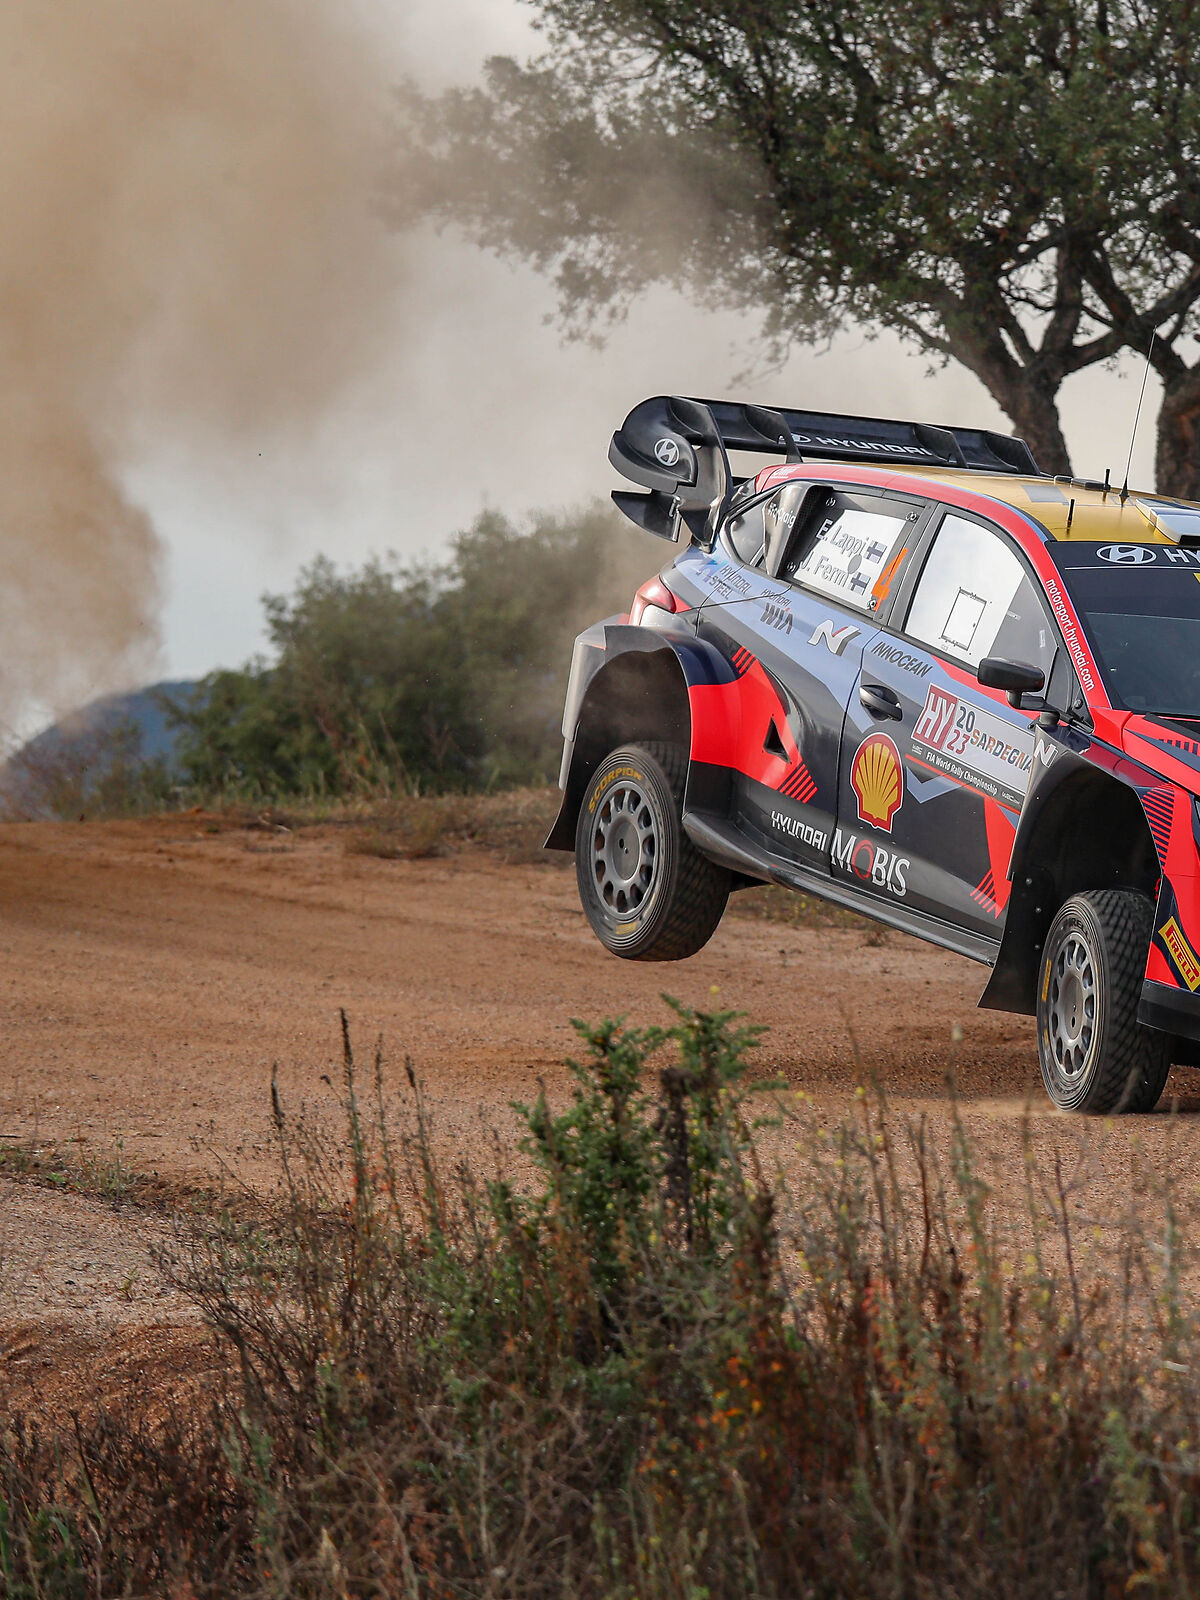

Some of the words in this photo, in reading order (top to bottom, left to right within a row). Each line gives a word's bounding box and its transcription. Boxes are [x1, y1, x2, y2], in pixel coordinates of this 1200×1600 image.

[816, 437, 933, 456] HYUNDAI
[816, 519, 834, 541] E.
[830, 525, 870, 558] Lappi
[709, 575, 734, 600] STEEL
[720, 565, 752, 595] HYUNDAI
[814, 555, 850, 588] Ferm
[871, 548, 909, 611] 4
[760, 589, 792, 607] HYUNDAI
[760, 603, 793, 635] WIA
[1046, 579, 1095, 692] motorsport.hyundai.com
[871, 641, 933, 678] INNOCEAN
[956, 706, 976, 733] 20
[947, 730, 970, 755] 23
[970, 729, 1034, 773] SARDEGNA
[588, 767, 643, 813] SCORPION
[926, 751, 936, 764] FIA
[936, 757, 952, 772] World
[951, 764, 965, 778] Rally
[964, 771, 998, 796] Championship
[771, 810, 828, 851] HYUNDAI
[830, 828, 910, 897] MOBIS
[1165, 924, 1200, 983] PIRELLI
